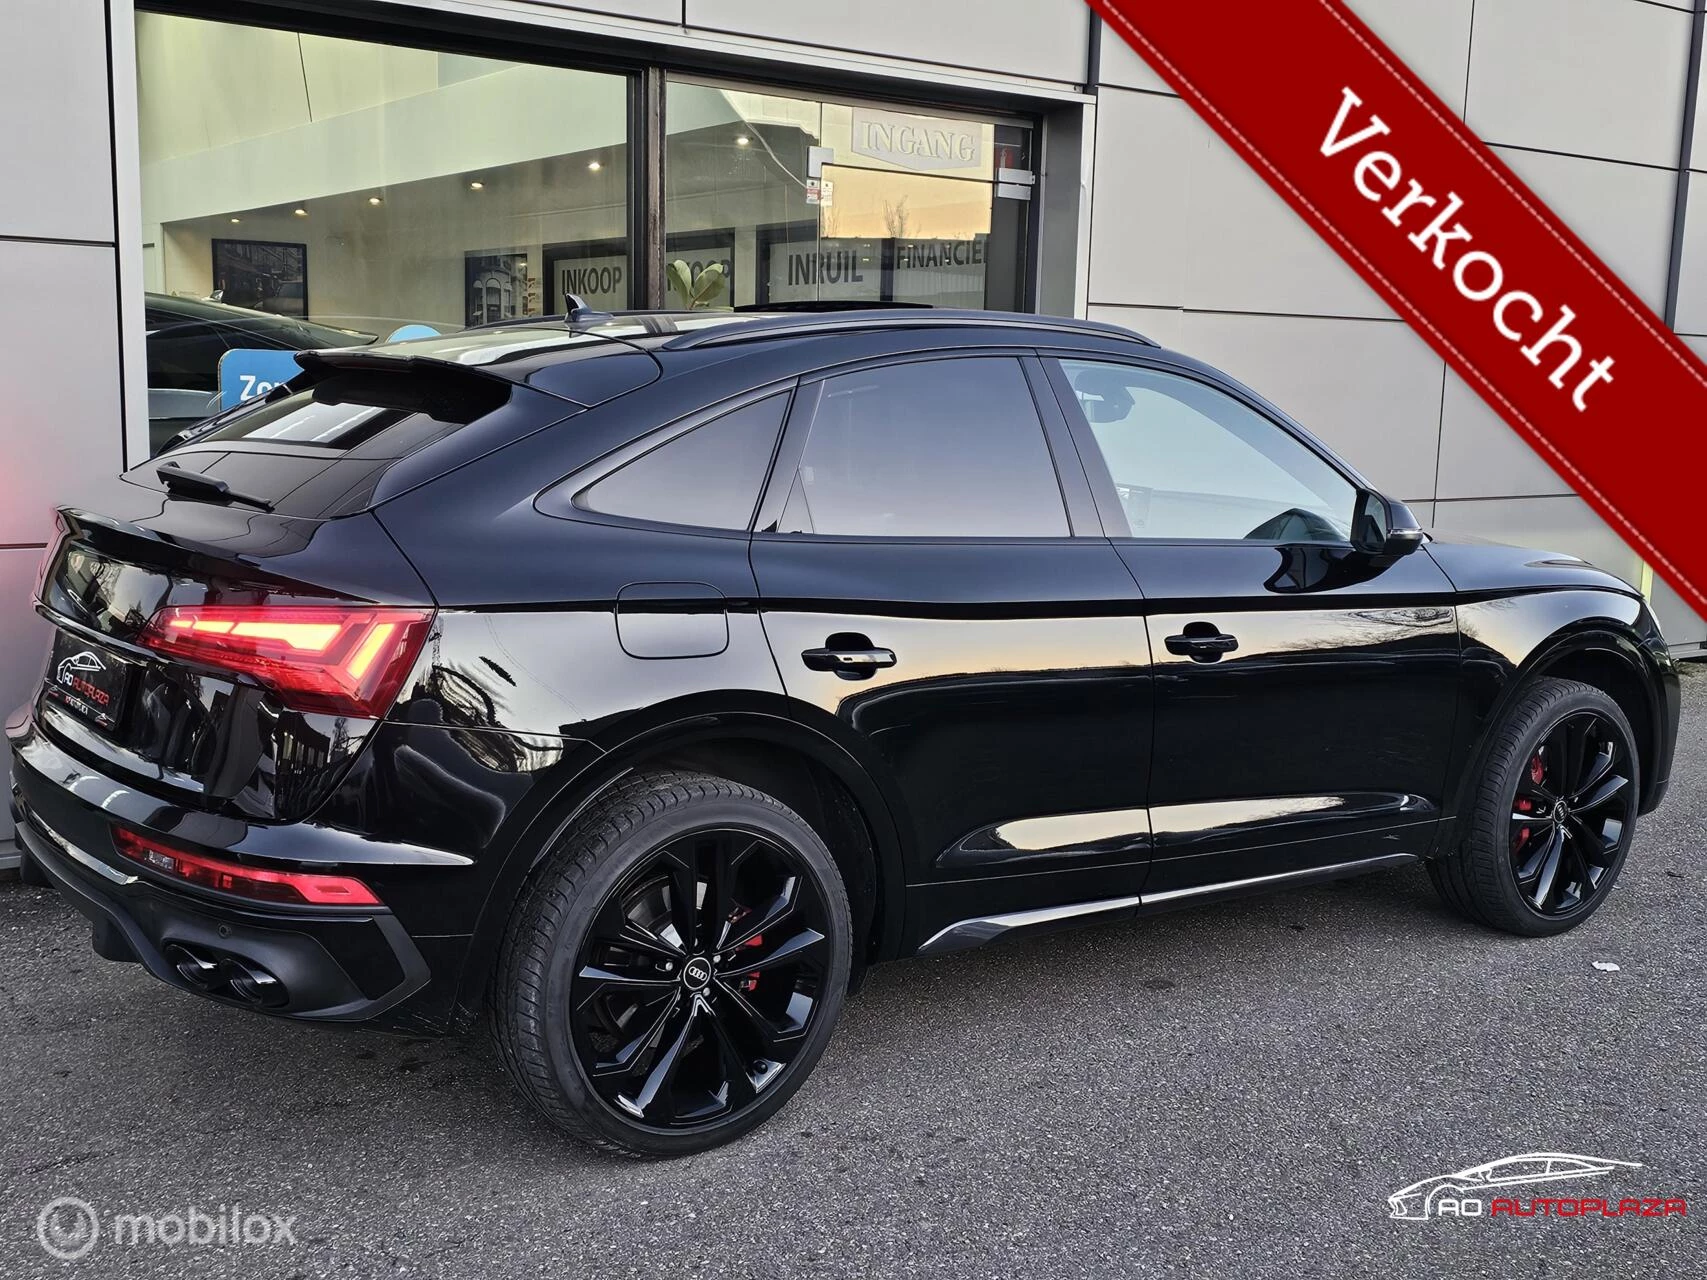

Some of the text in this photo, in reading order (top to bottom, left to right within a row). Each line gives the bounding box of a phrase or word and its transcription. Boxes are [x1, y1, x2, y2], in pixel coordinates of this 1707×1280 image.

[860, 121, 976, 162] INGANG
[788, 251, 863, 286] INRUIL
[896, 240, 986, 270] FINANCIE
[561, 266, 623, 295] INKOOP
